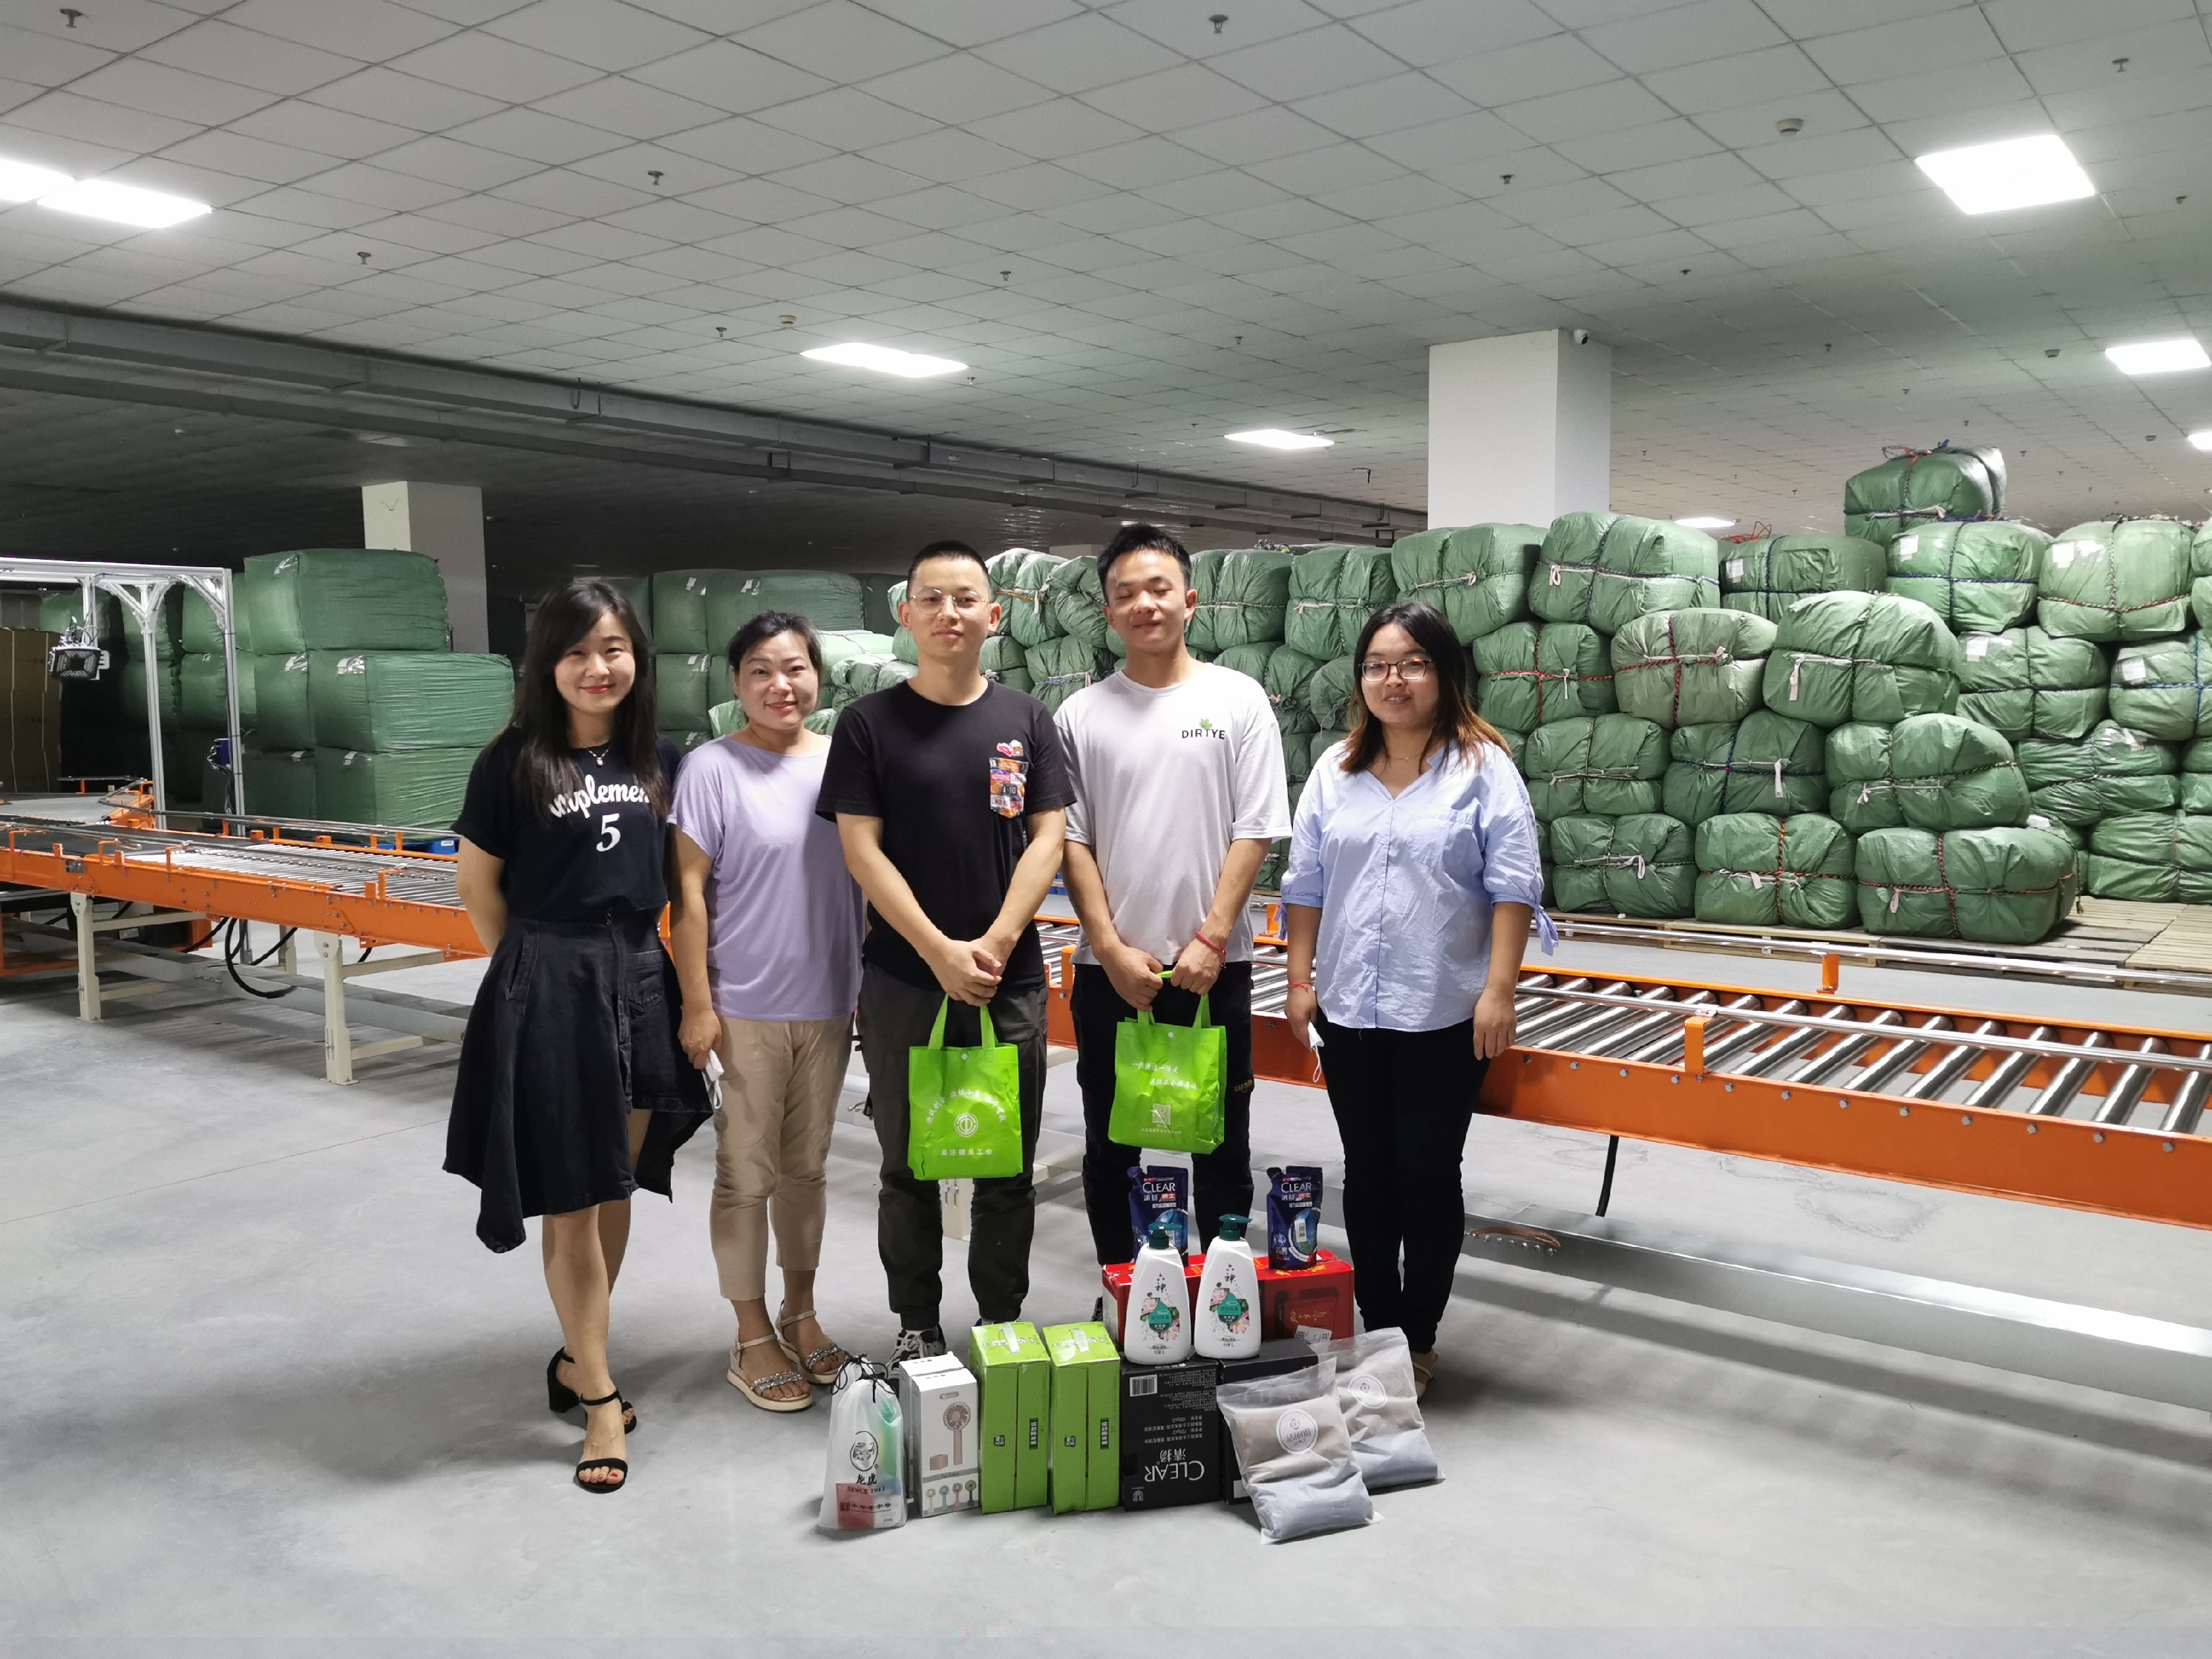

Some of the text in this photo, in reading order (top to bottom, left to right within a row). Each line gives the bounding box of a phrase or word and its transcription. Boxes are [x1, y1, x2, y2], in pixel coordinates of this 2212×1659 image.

[1181, 729, 1225, 739] DIRTYE
[549, 775, 650, 819] implemen
[596, 813, 621, 852] 5
[1143, 1182, 1176, 1193] CLEAR
[1281, 1182, 1312, 1193] CLEAR
[1155, 1273, 1167, 1293] 六神
[1160, 1448, 1186, 1462] 清扬
[1145, 1460, 1205, 1482] CLEAR
[855, 1473, 878, 1485] 龙虎
[848, 1486, 869, 1494] SINCE
